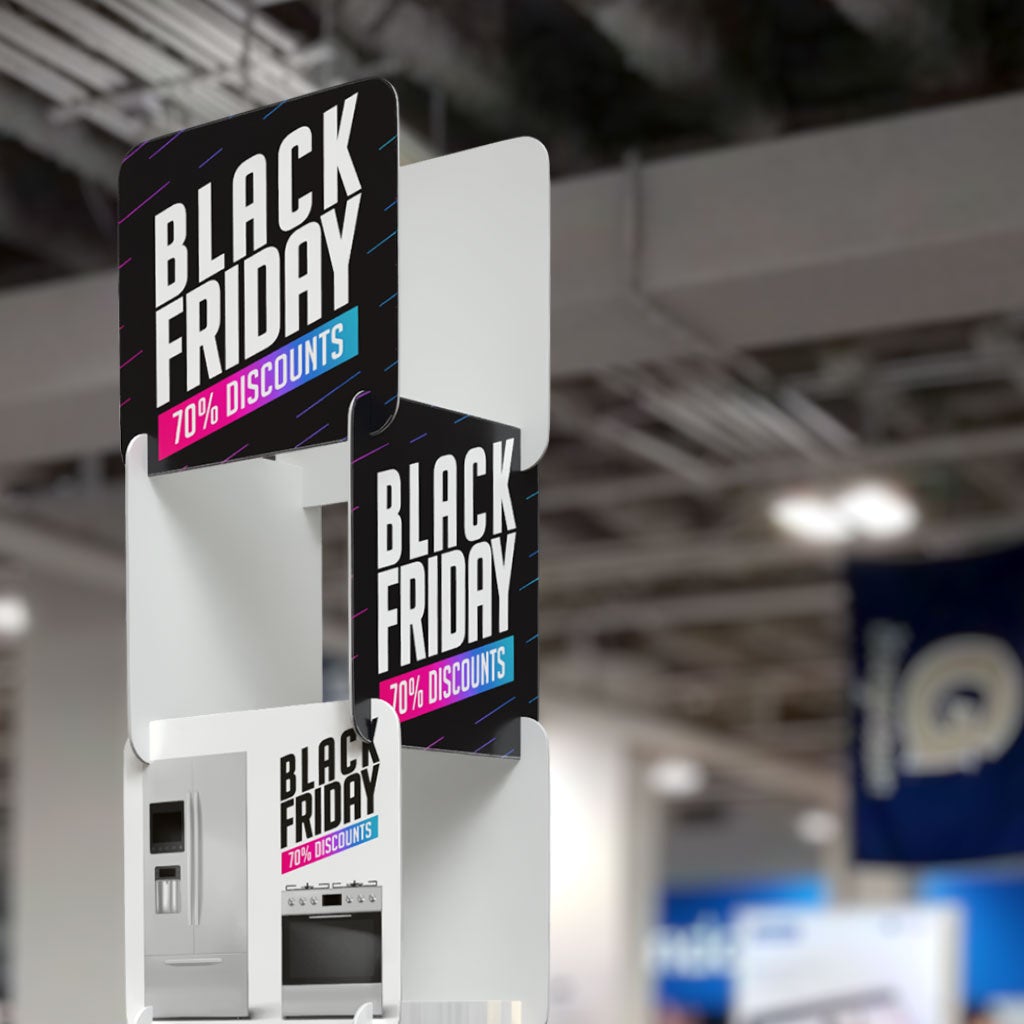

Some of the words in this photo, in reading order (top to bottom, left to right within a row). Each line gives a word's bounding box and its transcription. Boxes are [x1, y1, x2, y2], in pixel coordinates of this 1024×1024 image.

[154, 92, 362, 309] BLACK
[155, 192, 362, 409] FRIDAY
[172, 392, 219, 445] 70%
[226, 323, 344, 418] DISCOUNTS
[377, 438, 517, 570] BLACK
[377, 532, 517, 674] FRIDAY
[389, 675, 424, 715] 70%
[428, 646, 506, 704] DISCOUNTS
[280, 717, 380, 801] BLACK
[280, 763, 380, 849] FRIDAY
[288, 845, 312, 868] 70%
[314, 821, 373, 859] DISCOUNTS
